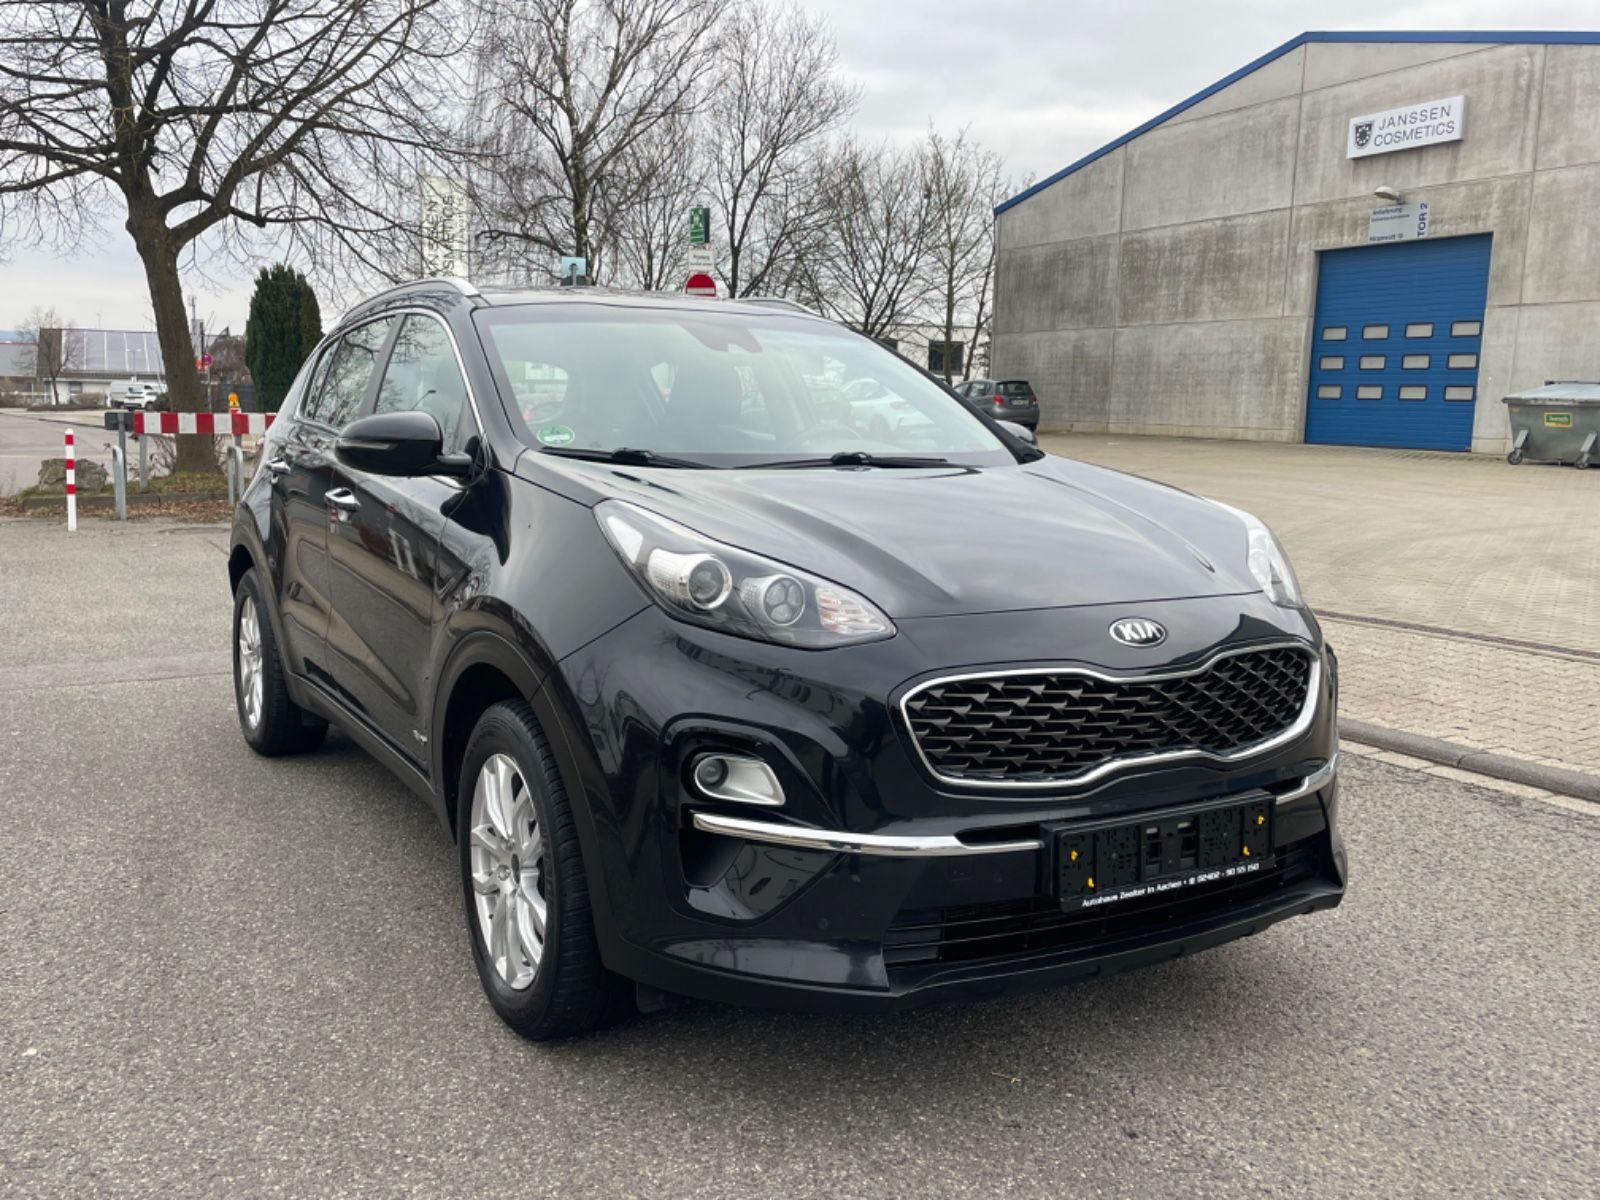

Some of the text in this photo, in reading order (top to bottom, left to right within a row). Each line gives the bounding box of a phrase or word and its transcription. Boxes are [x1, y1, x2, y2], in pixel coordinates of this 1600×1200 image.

[1378, 105, 1451, 131] JANSSEN
[1374, 121, 1455, 147] COSMETICS
[1416, 202, 1428, 238] TOR 2
[1116, 621, 1161, 641] KIA
